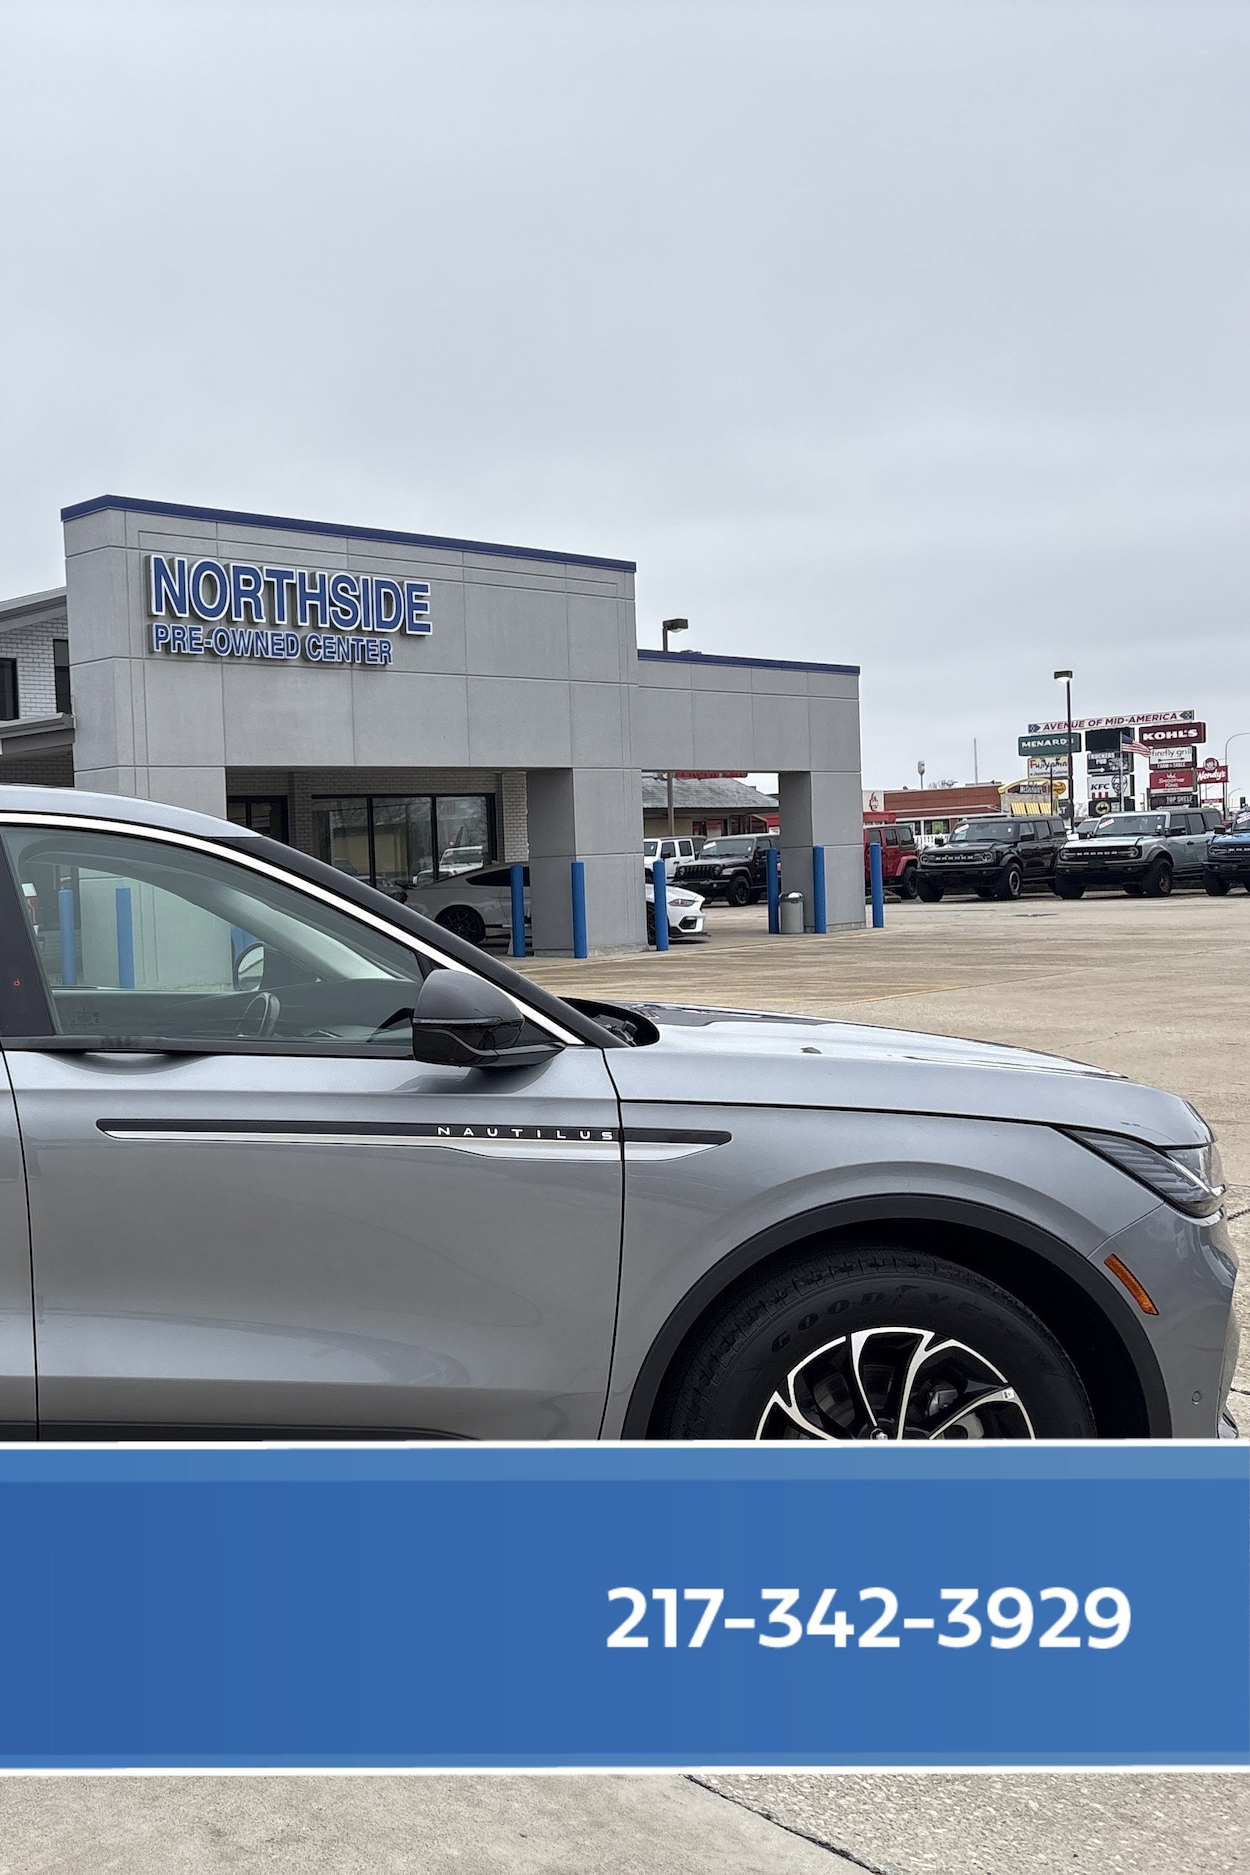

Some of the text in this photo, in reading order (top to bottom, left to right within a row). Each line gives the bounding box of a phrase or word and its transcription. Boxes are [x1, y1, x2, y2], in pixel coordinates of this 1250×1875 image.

[149, 554, 433, 635] NORTHSIDE
[152, 623, 393, 665] PRE-OWNED CENTER
[1043, 713, 1178, 731] AVENUE OF MID-AMERICA
[1142, 728, 1198, 741] KOHL'S
[1151, 747, 1192, 757] firefly grill
[1090, 783, 1110, 791] KFC
[437, 1126, 613, 1140] NAUTILUS
